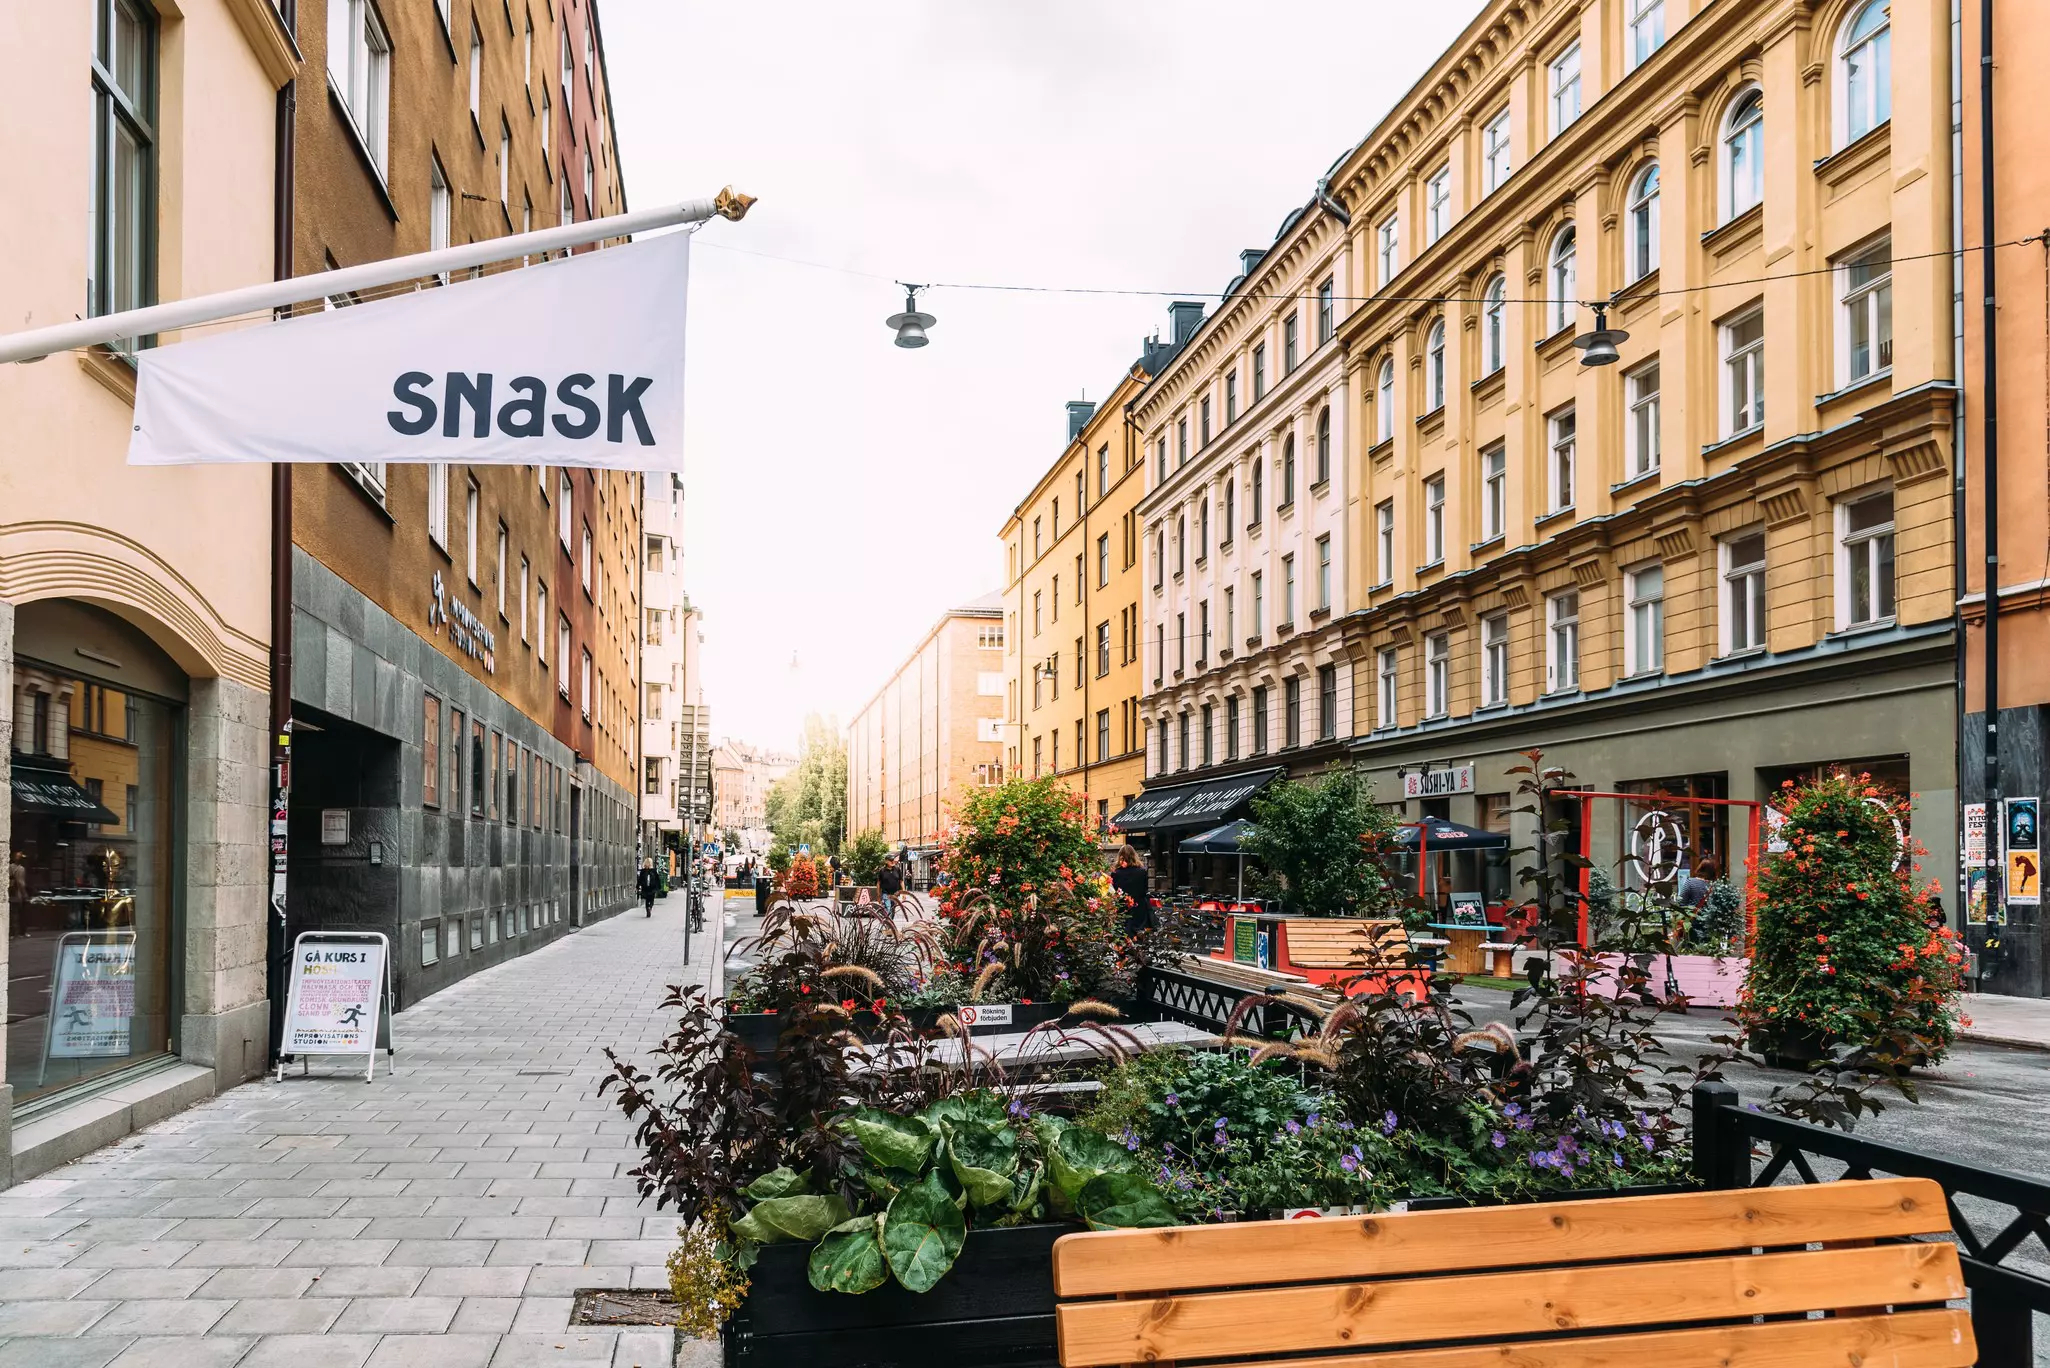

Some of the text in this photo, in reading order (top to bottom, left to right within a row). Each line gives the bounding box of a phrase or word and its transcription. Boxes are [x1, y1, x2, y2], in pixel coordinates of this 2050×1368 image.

[1420, 771, 1455, 794] SUSHI-YA
[305, 949, 366, 963] GÅ KURS I
